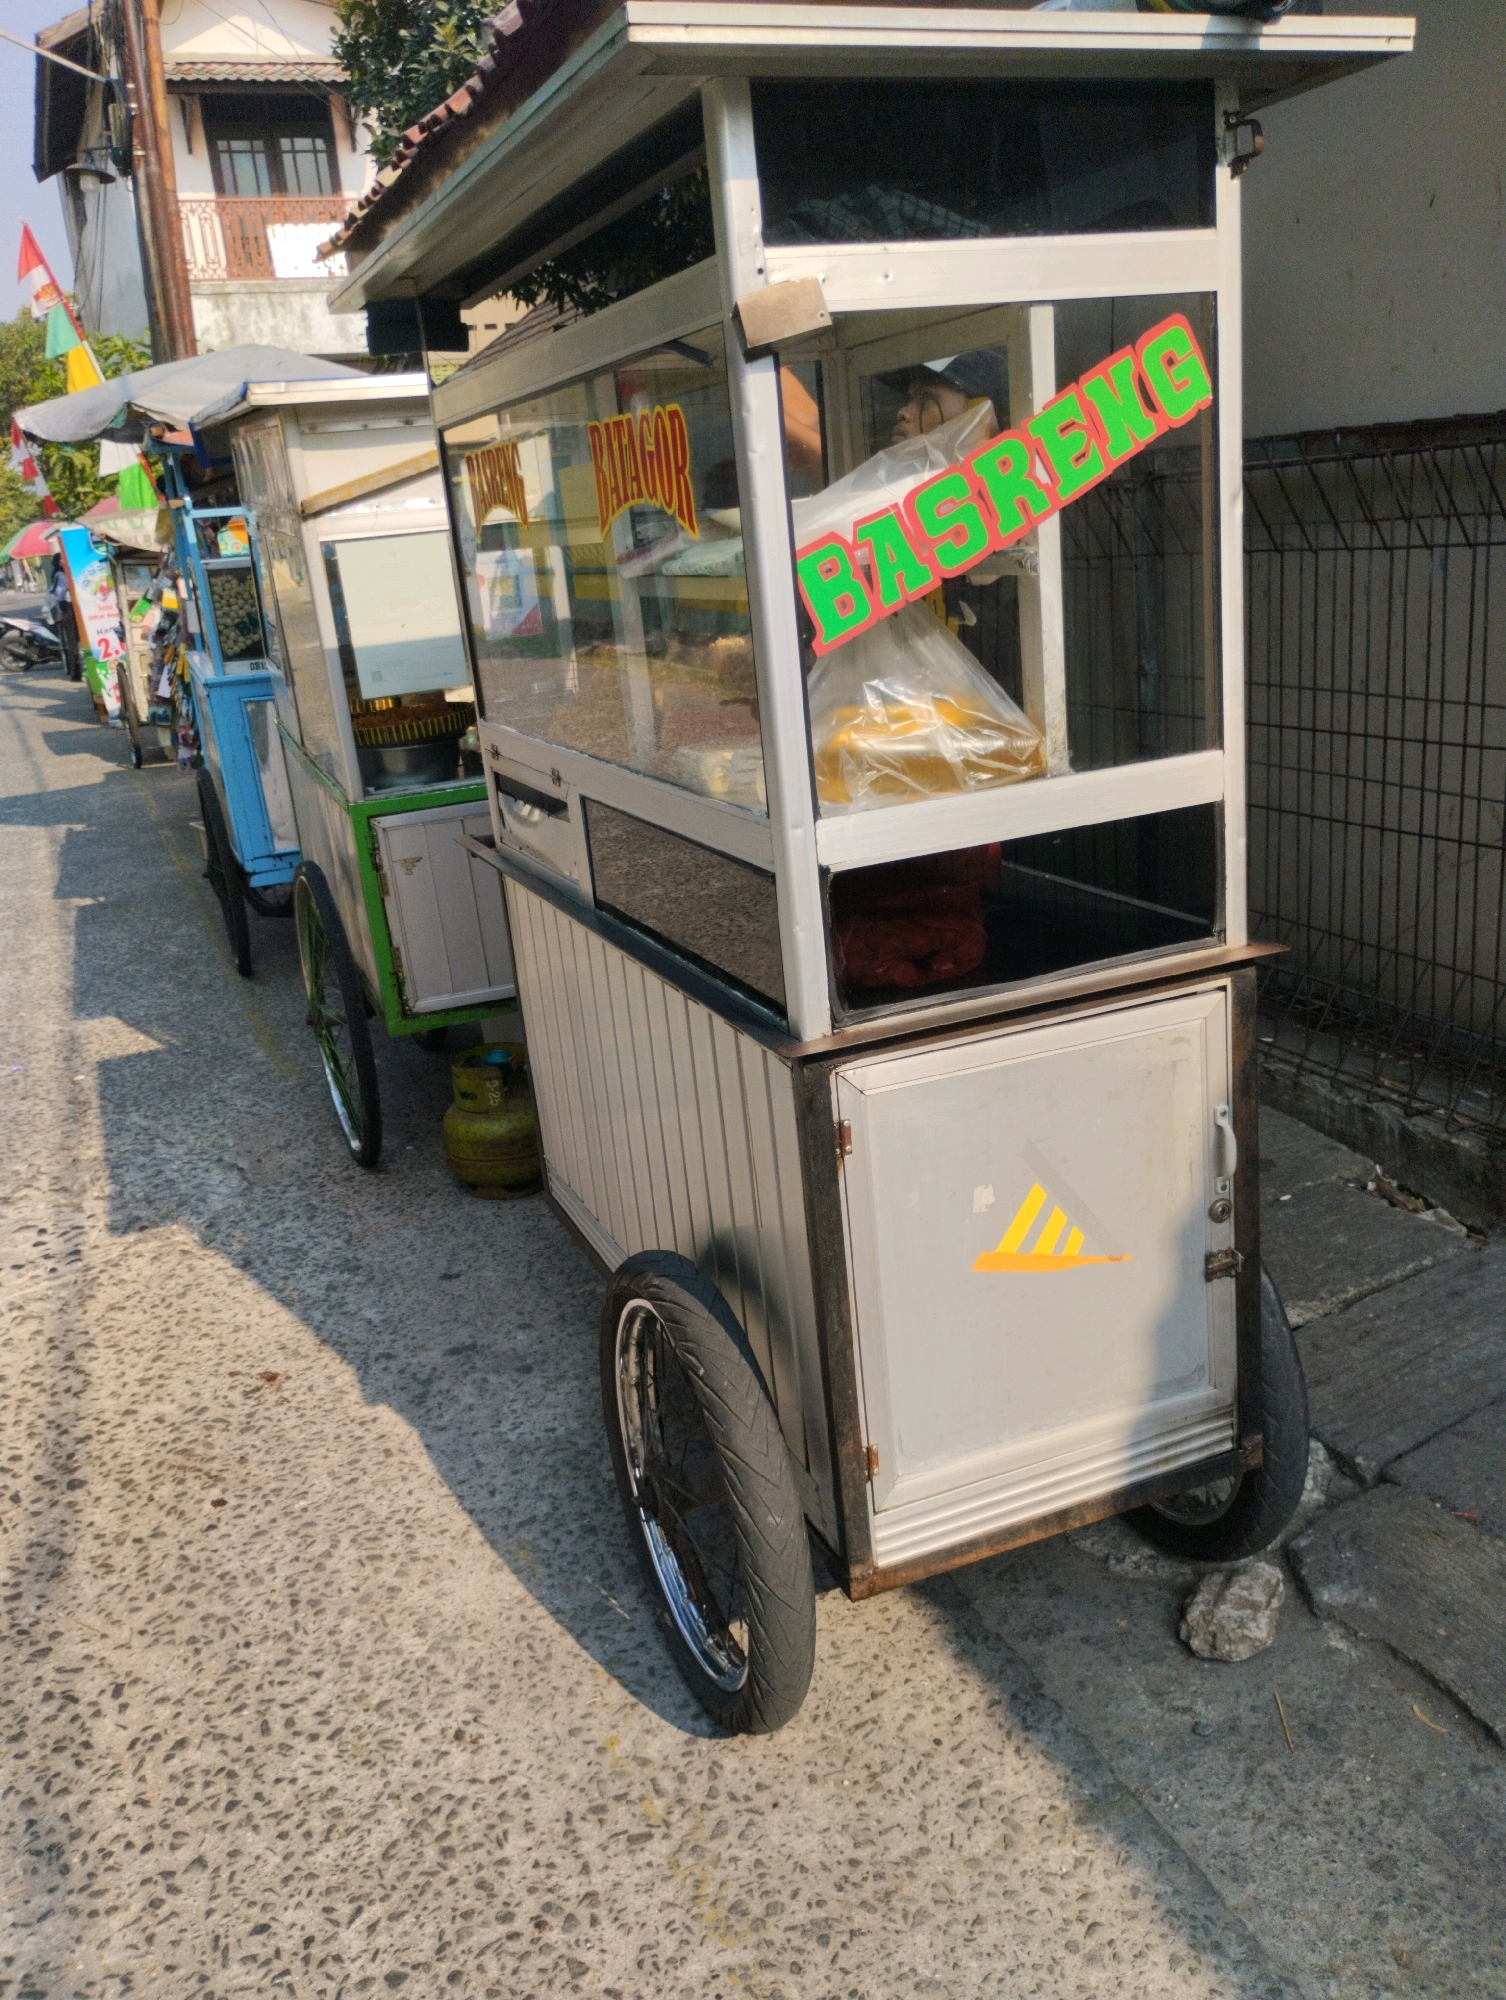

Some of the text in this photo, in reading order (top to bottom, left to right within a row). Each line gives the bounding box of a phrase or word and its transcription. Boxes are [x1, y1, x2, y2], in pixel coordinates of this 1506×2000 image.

[465, 438, 530, 543] BASRENG
[588, 403, 698, 540] BATAGOR
[796, 314, 1213, 655] BASRENG
